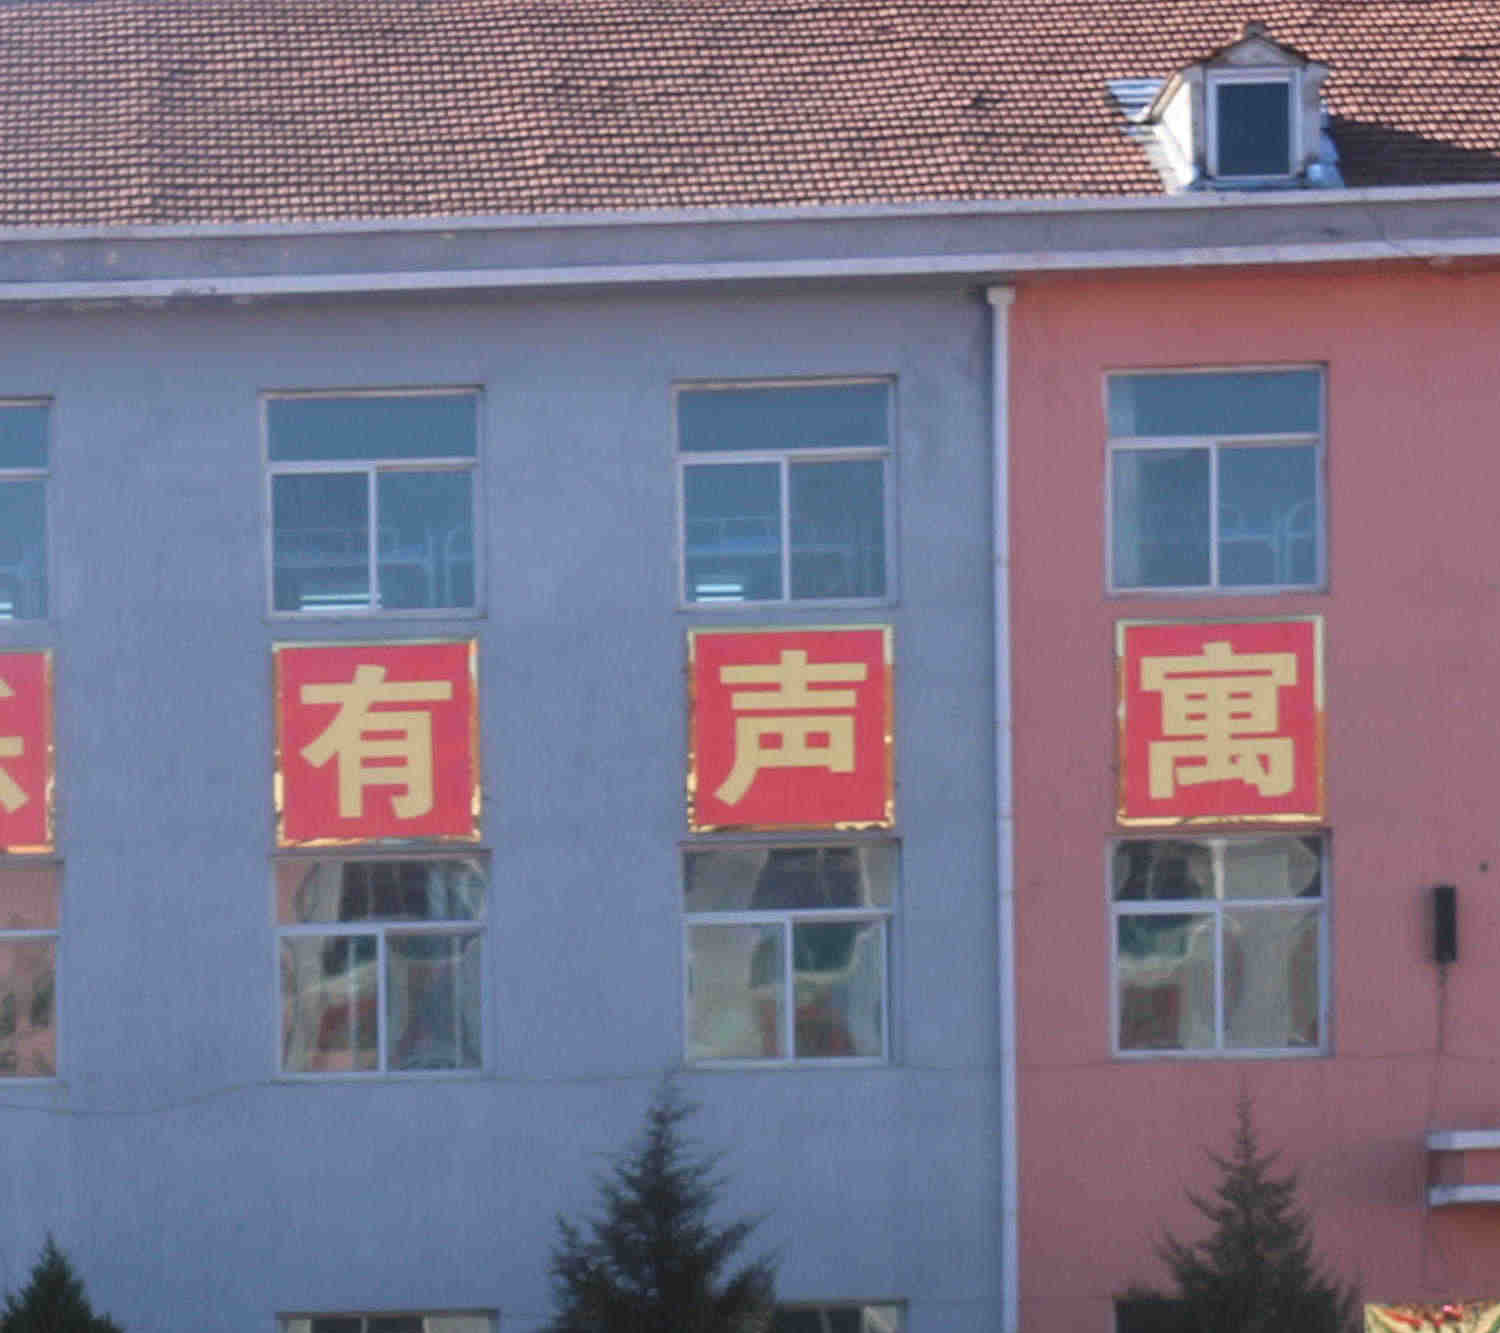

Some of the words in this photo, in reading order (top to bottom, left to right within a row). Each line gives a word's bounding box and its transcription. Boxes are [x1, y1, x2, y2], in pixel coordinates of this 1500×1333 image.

[299, 664, 453, 820] 有
[714, 650, 868, 806] 声
[1140, 641, 1298, 800] 寓
